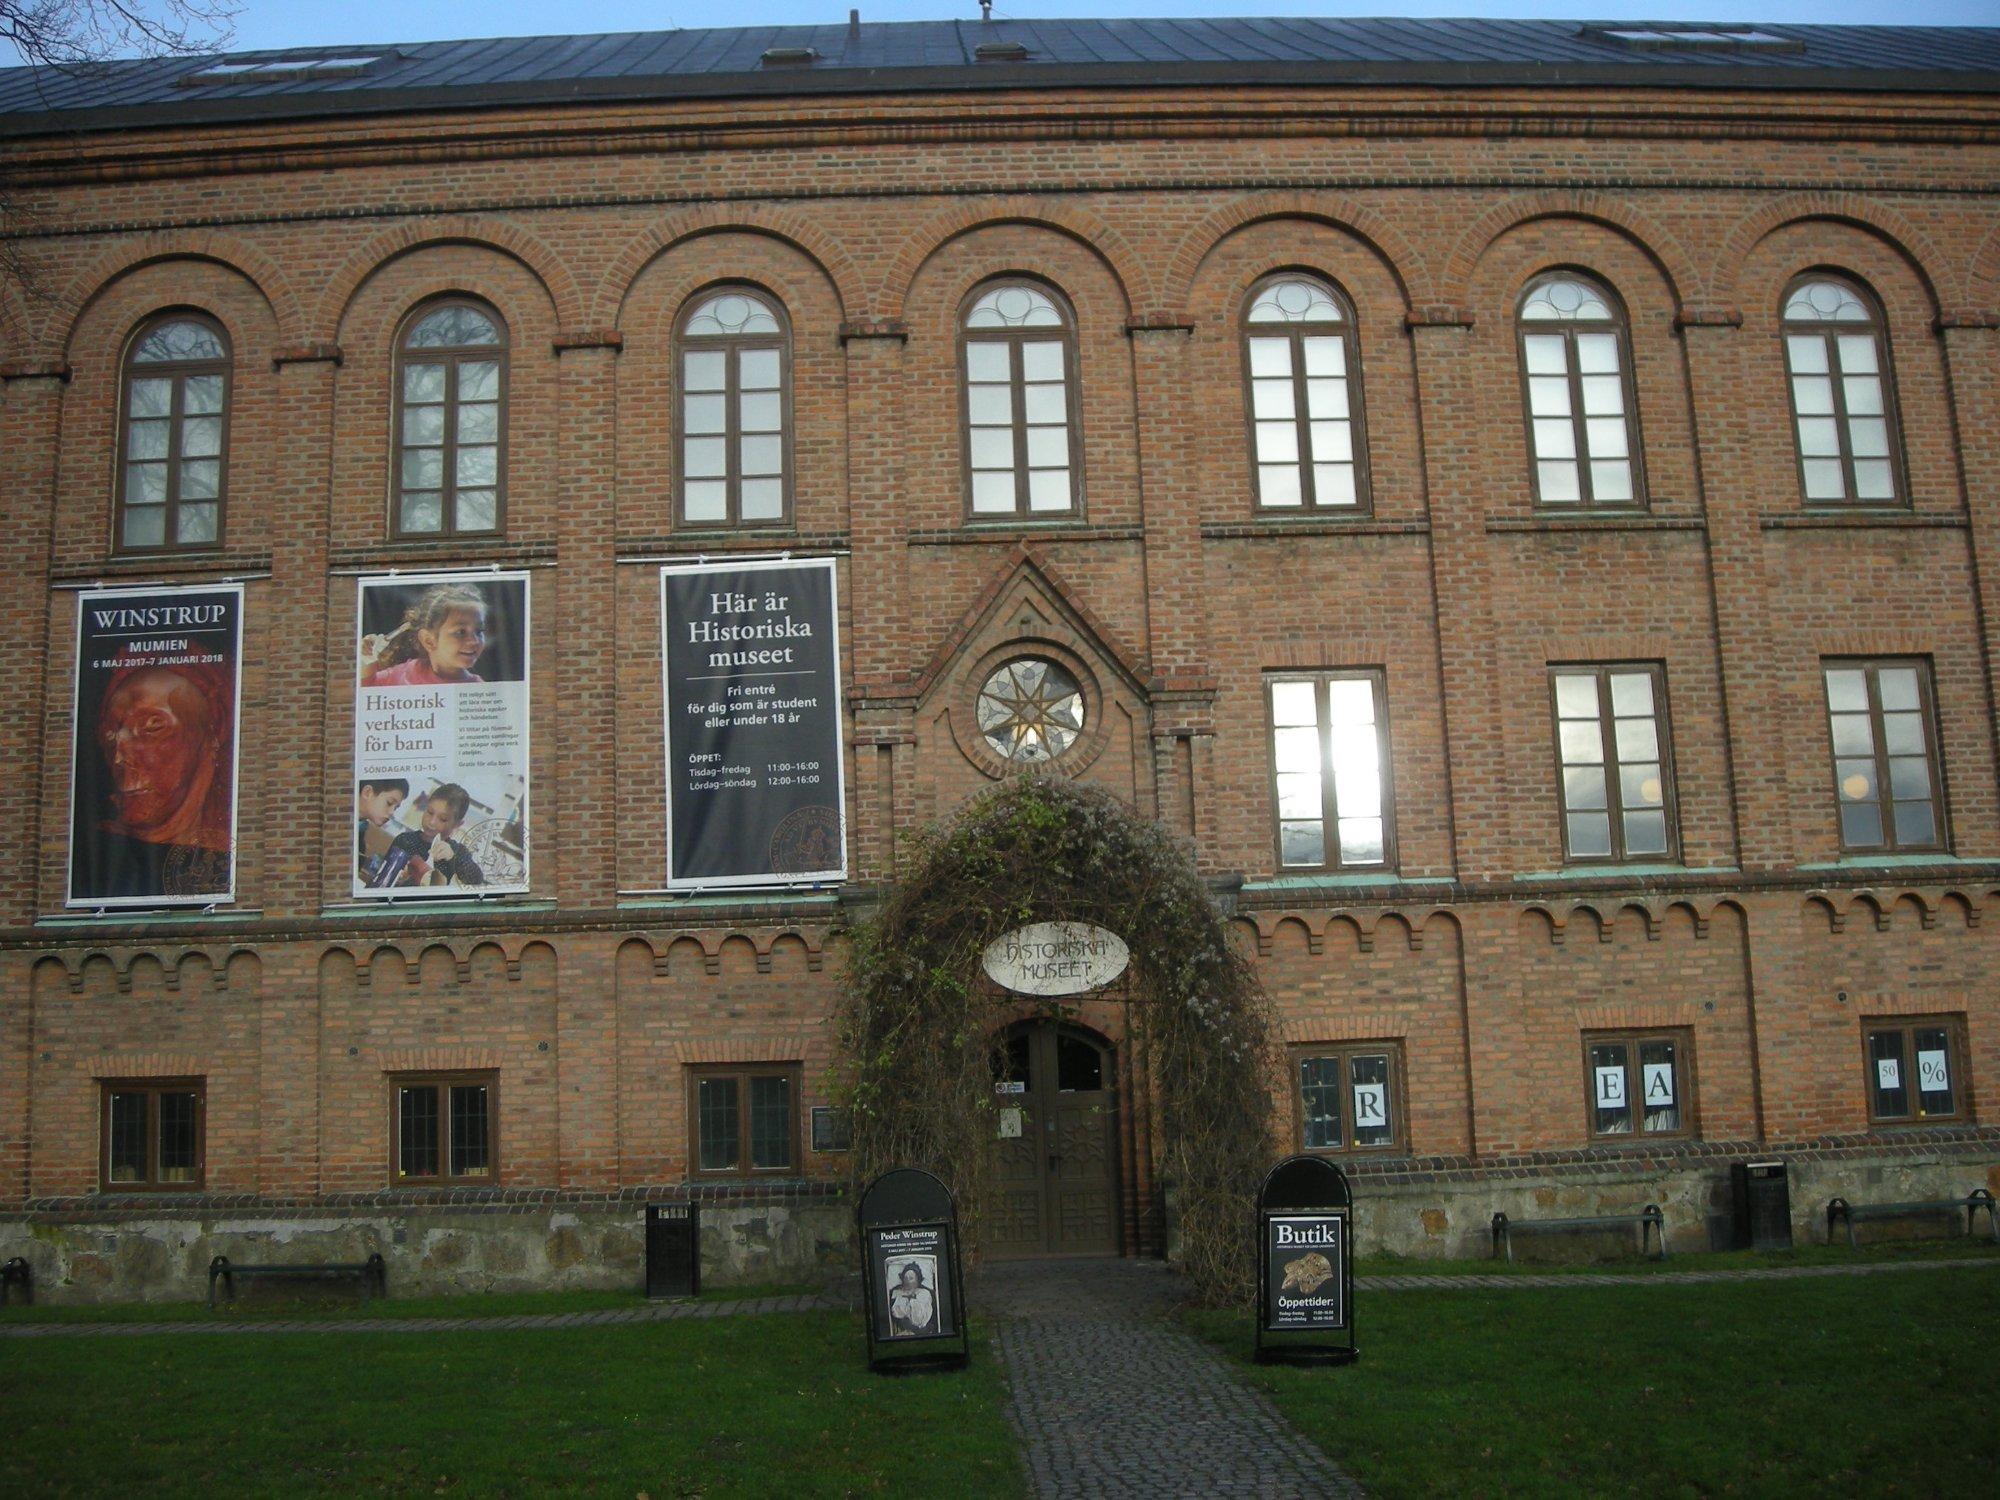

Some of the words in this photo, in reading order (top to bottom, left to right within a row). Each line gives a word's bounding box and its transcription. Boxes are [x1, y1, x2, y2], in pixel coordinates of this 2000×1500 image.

[710, 592, 757, 614] Här
[764, 592, 788, 611] är
[93, 604, 226, 629] WINSTRUP
[688, 614, 813, 643] Historiska
[129, 639, 188, 653] MUMIEN
[93, 660, 100, 668] 6
[102, 660, 122, 668] MAJ
[158, 655, 198, 666] JANUARI
[201, 654, 224, 664] 2018
[708, 646, 794, 668] museet
[728, 686, 741, 697] Fri
[744, 684, 776, 696] entré
[366, 692, 446, 711] Historisk
[687, 703, 705, 714] för
[708, 702, 726, 715] dig
[730, 702, 754, 712] som
[756, 700, 768, 710] är
[772, 696, 818, 708] student
[364, 712, 436, 732] verkstad
[704, 717, 730, 728] eller
[733, 714, 768, 726] under
[772, 714, 785, 724] 18
[788, 712, 800, 723] år
[364, 734, 390, 752] för
[395, 734, 434, 751] barn
[688, 752, 722, 764] ÖPPET:
[1023, 961, 1092, 980] MUSEET
[1882, 1065, 1896, 1077] 50
[1922, 1060, 1946, 1084] %
[1600, 1073, 1622, 1100] E
[1648, 1070, 1672, 1098] A
[1358, 1092, 1384, 1119] R
[880, 1232, 900, 1240] Peder
[902, 1230, 938, 1239] Winstrup
[1276, 1224, 1336, 1244] Butik
[1278, 1296, 1334, 1309] Öppettider:
